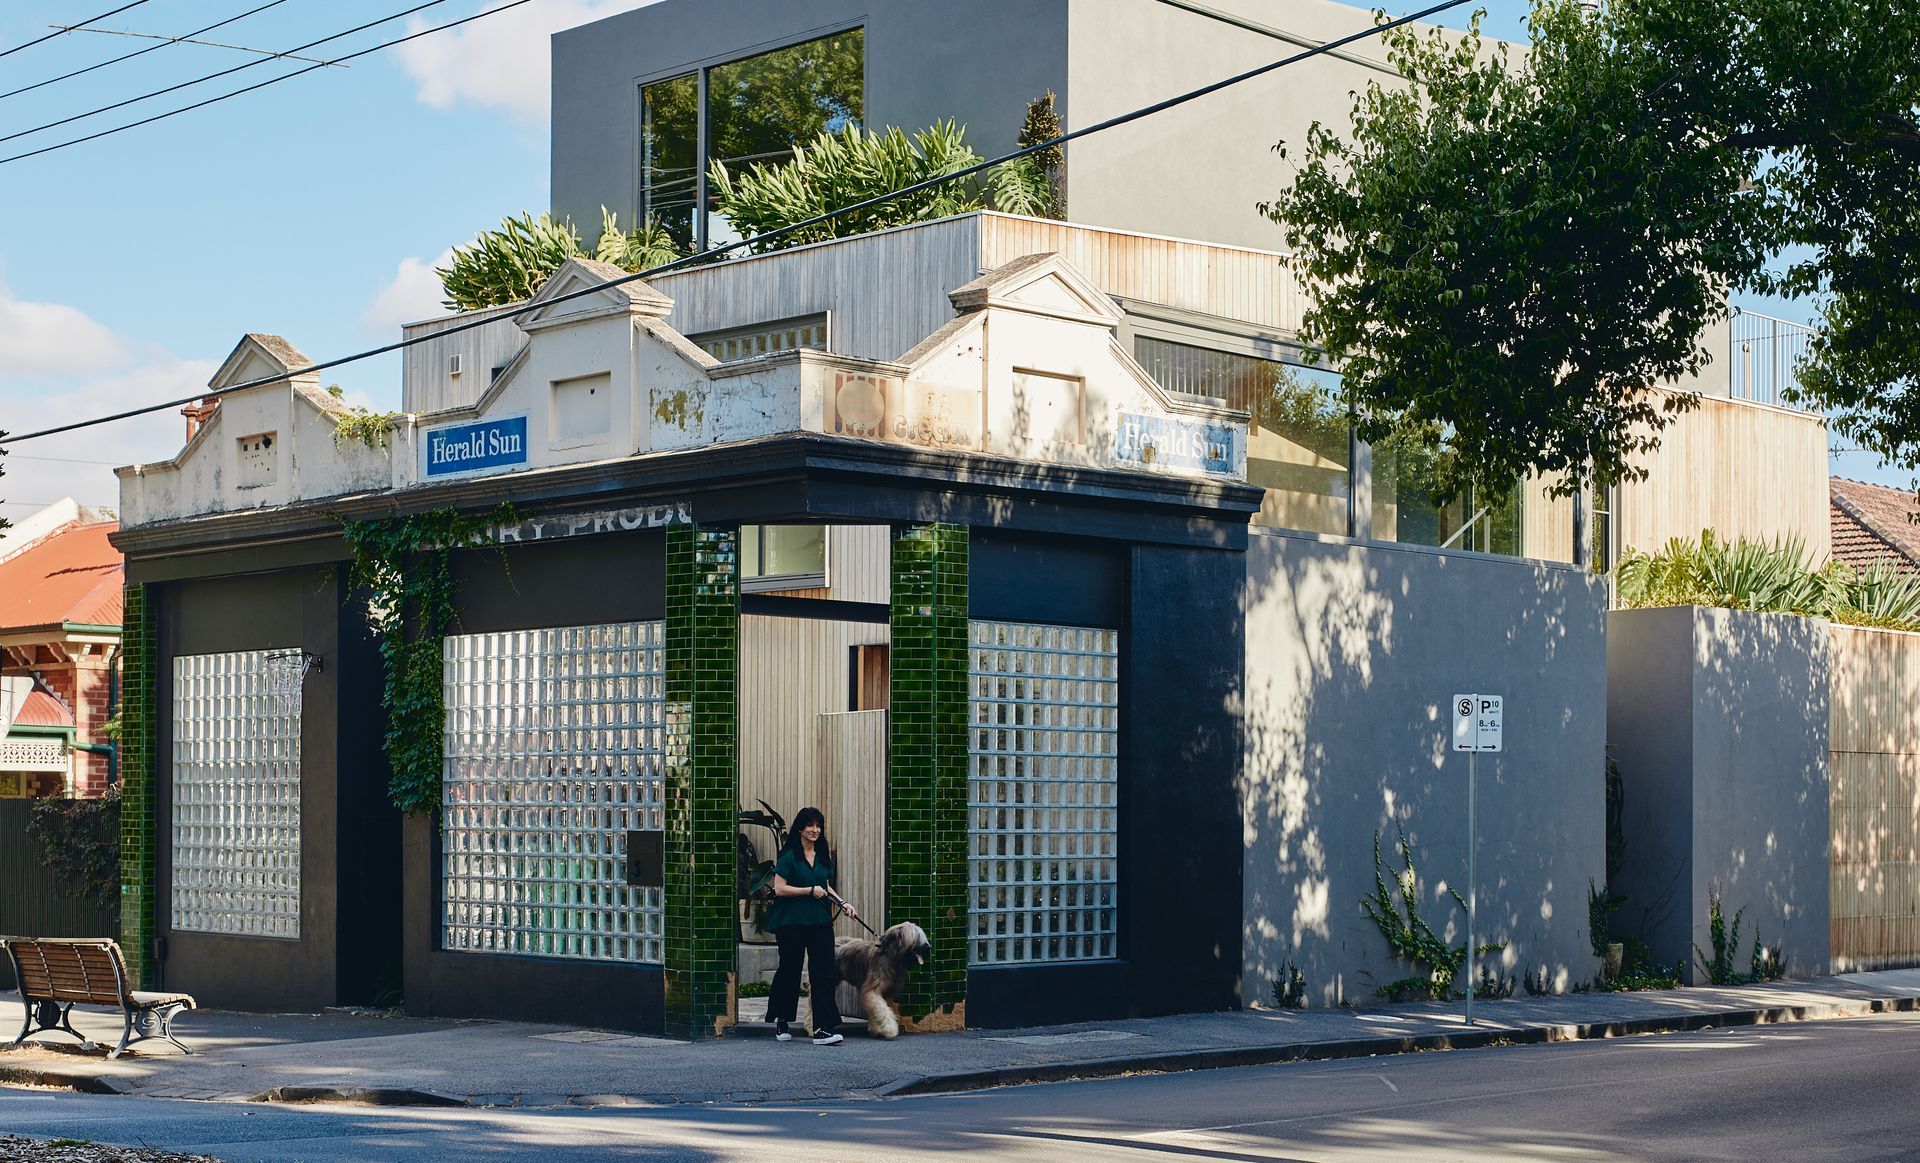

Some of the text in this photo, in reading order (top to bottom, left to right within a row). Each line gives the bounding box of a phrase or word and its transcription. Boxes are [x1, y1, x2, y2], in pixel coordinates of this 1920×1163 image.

[432, 428, 522, 464] Herald Sun
[1121, 421, 1228, 462] Herald Sun
